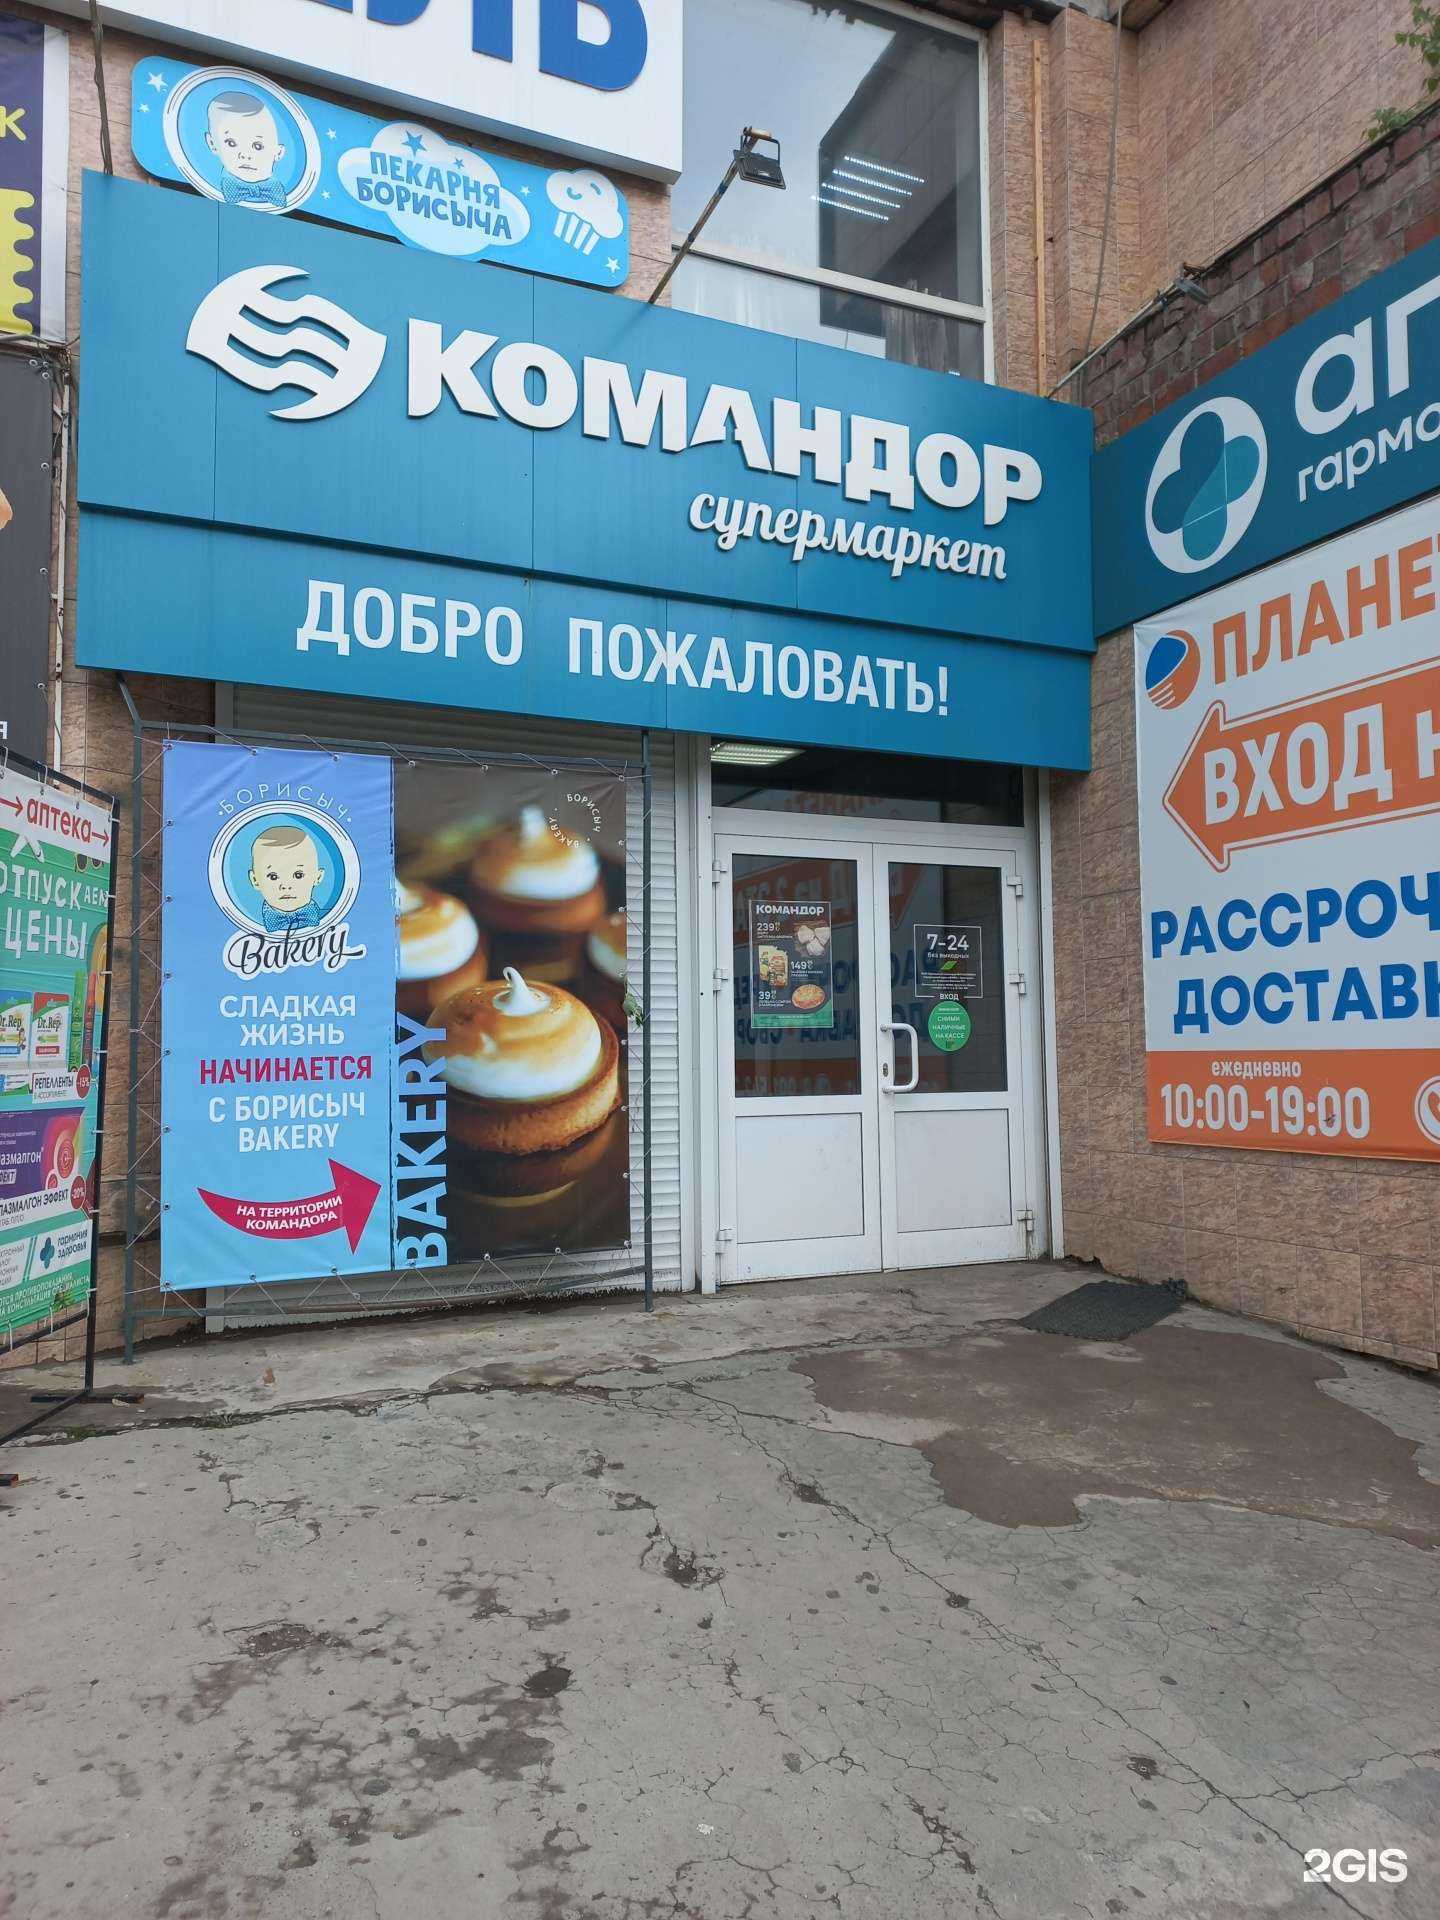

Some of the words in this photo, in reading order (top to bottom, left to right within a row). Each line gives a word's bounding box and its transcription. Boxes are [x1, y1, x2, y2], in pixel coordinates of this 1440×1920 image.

[369, 151, 501, 209] ПЕКАРНЯ
[356, 176, 512, 239] БОРИСЫЧА
[407, 317, 1043, 526] КОМАНДОР
[689, 491, 1007, 580] супермаркет
[1212, 530, 1440, 685] ПЛАНЕ
[296, 578, 523, 666] ДОБРО
[568, 617, 949, 716] ПОЖАЛОВАТЬ!
[1203, 702, 1393, 826] ВХОД
[220, 783, 348, 819] БОРИСЫЧ
[567, 793, 602, 833] БОРИСЫЧ
[26, 798, 92, 844] аптека
[755, 904, 825, 917] КОМАНДОР
[757, 922, 774, 931] 239
[5, 906, 87, 959] ЦЕНЫ
[228, 919, 364, 975] Bakery
[926, 933, 970, 951] 7-24
[219, 994, 357, 1021] СЛАДКАЯ
[939, 993, 960, 1001] ВХОД
[239, 1022, 345, 1047] ЖИЗНЬ
[199, 1055, 373, 1085] НАЧИНАЕТСЯ
[1211, 1060, 1302, 1080] ежедневно
[209, 1096, 226, 1123] С
[235, 1092, 366, 1122] БОРИСЫЧ
[1160, 1083, 1370, 1139] 10:00-19:00
[238, 1122, 340, 1153] BAKERY
[396, 1011, 448, 1270] BAKERY
[236, 1205, 256, 1217] НА
[259, 1195, 343, 1218] ТЕРРИТОРИИ
[246, 1210, 338, 1230] КОМАНДОРА
